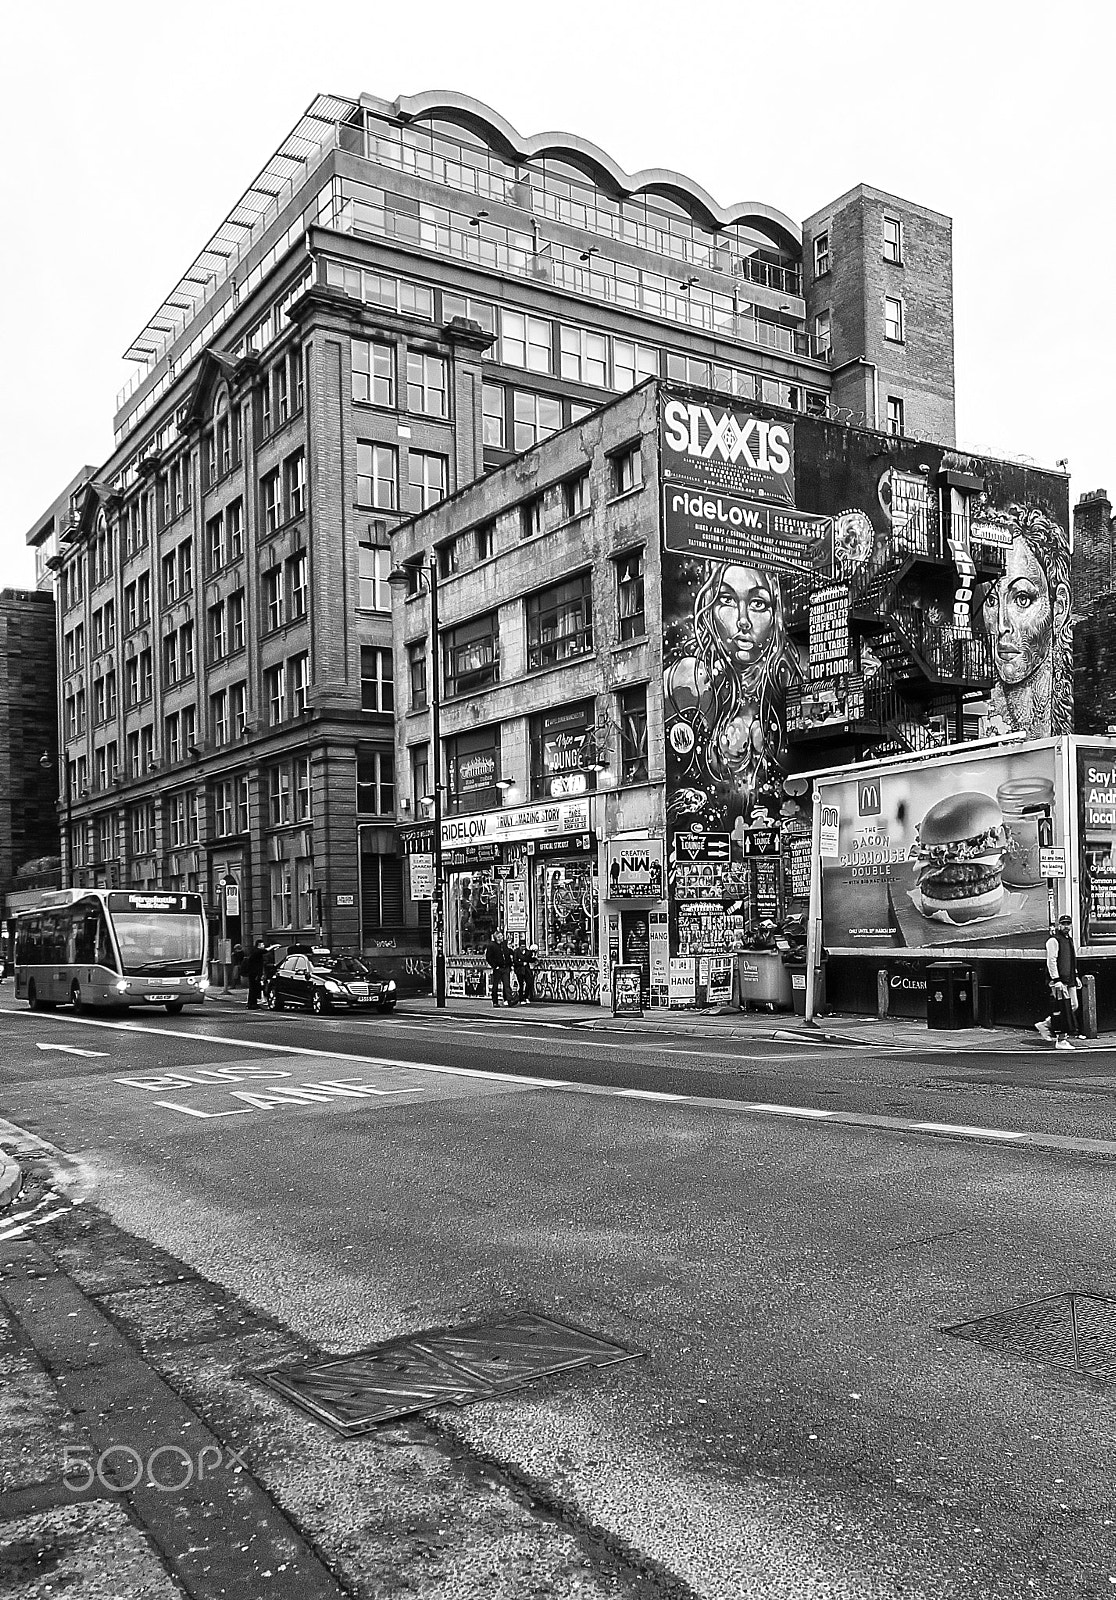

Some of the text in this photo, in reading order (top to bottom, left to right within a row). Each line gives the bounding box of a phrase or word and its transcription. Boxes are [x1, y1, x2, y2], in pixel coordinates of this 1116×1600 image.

[664, 401, 791, 474] SIXXIS
[825, 597, 849, 613] TATTOO
[809, 616, 849, 635] CAFE INK
[809, 637, 849, 654] POOL TABLE
[809, 658, 849, 680] TOP FLOOR
[1088, 767, 1111, 788] Say
[1089, 808, 1116, 824] local
[441, 819, 487, 841] RIDELOW
[864, 826, 877, 834] THE
[681, 841, 706, 850] LOUNGE
[754, 836, 771, 845] LOUNGE
[852, 835, 890, 851] BACON
[620, 849, 650, 857] CREATIVE
[840, 848, 906, 868] CLUBHOUSE
[620, 856, 650, 872] NW
[791, 868, 807, 876] CAFE
[851, 865, 892, 877] DOUBLE
[180, 896, 187, 910] 1
[650, 932, 668, 941] HANG
[670, 977, 695, 986] HANG
[113, 1066, 292, 1091] BUS
[153, 1078, 425, 1118] LANE
